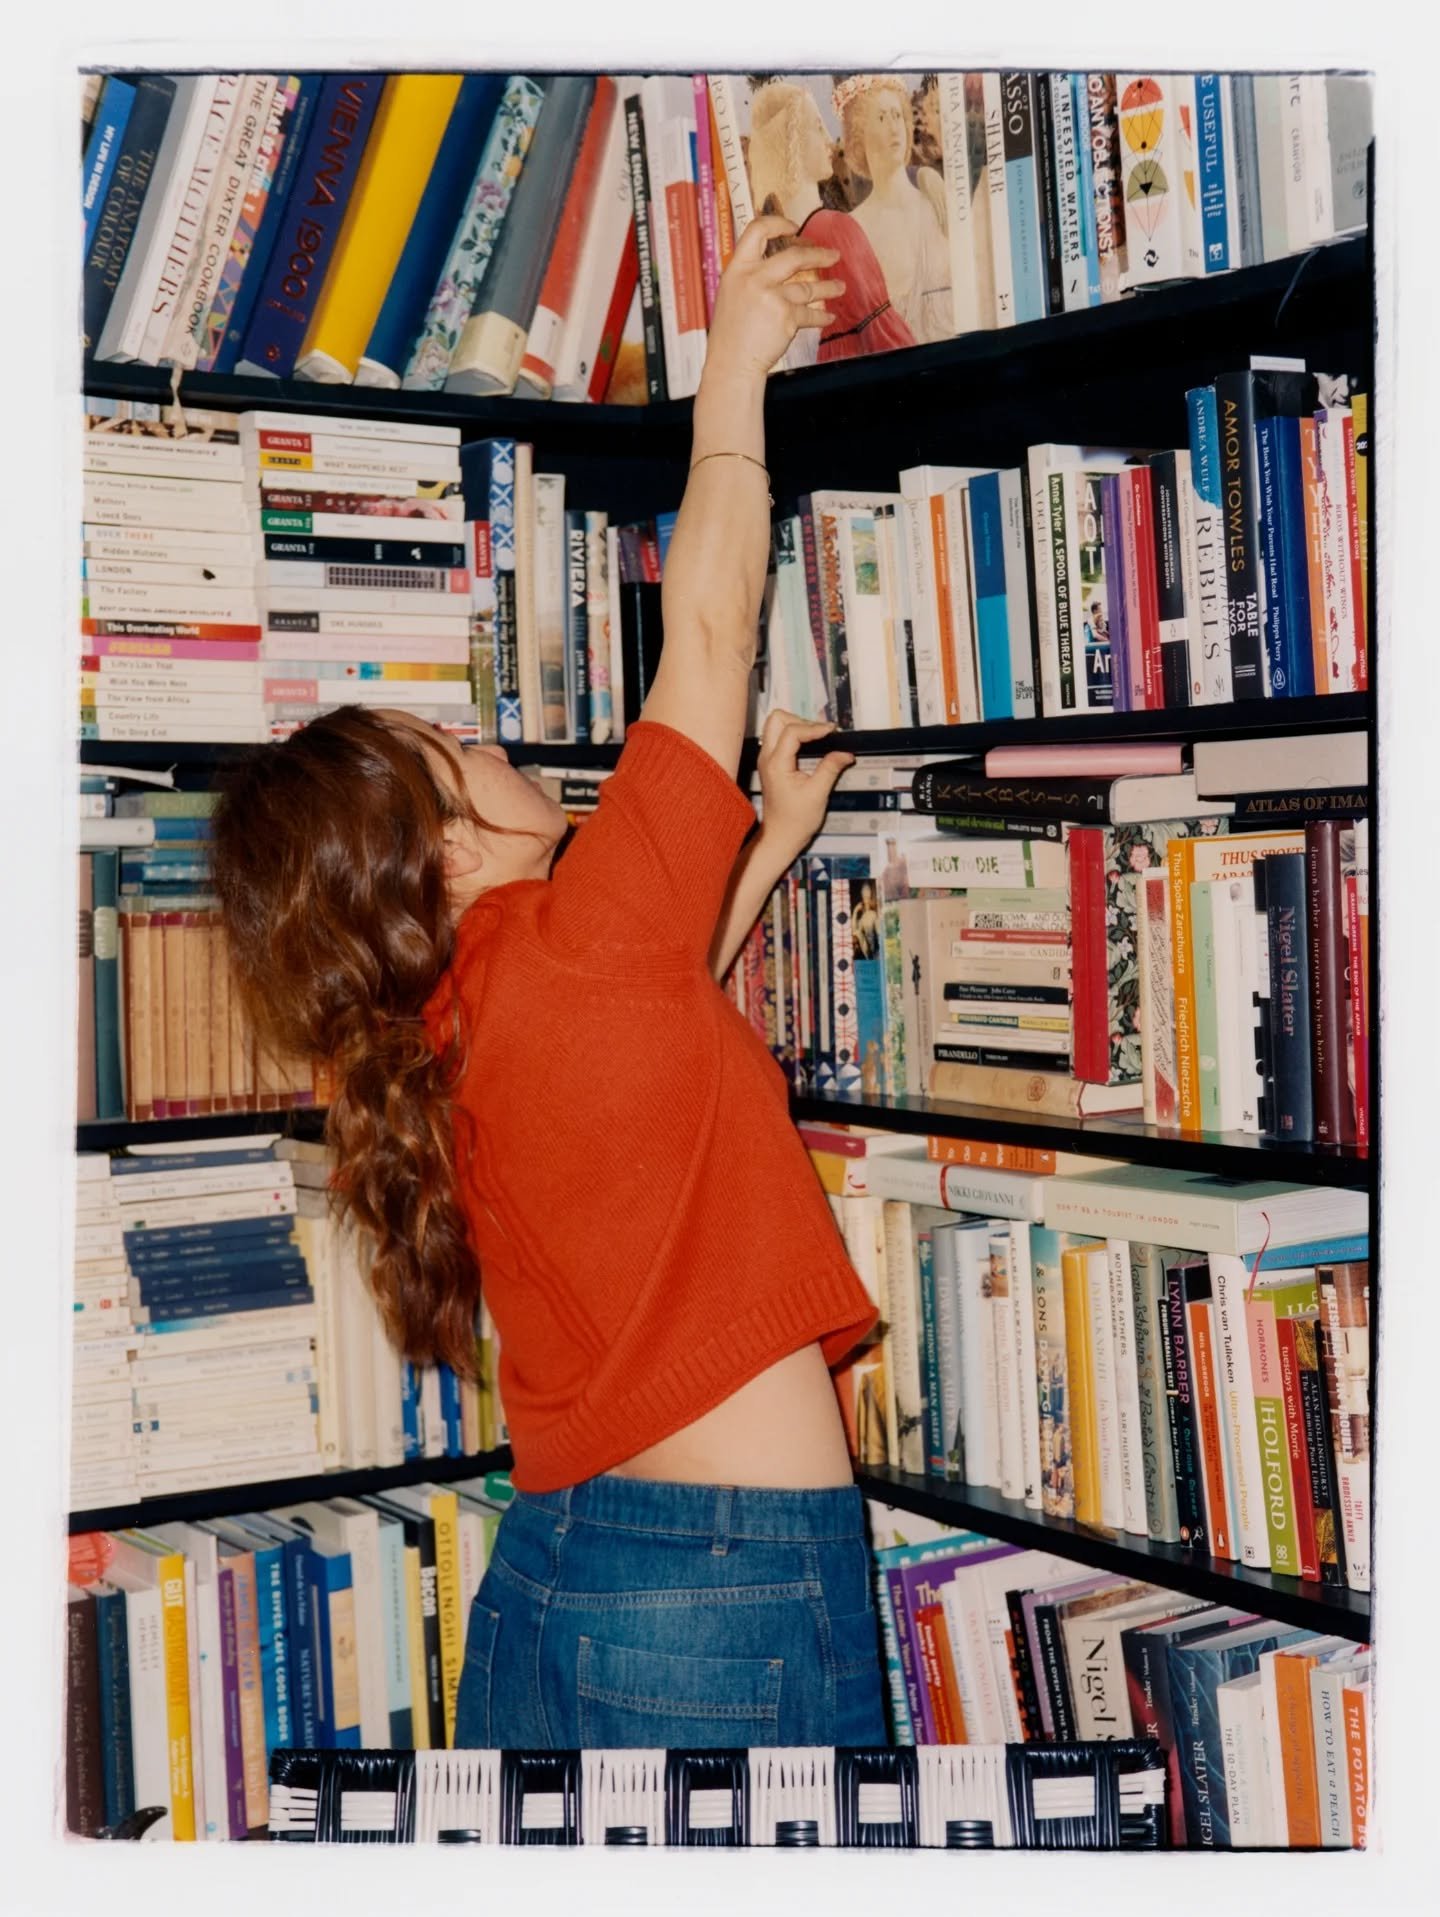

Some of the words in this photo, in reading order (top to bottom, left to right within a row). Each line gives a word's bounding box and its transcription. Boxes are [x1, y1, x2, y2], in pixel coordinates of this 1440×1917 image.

[247, 79, 268, 111] THE
[1053, 86, 1063, 140] COLLECTION
[627, 111, 641, 146] NEW
[1090, 95, 1105, 134] ANY
[1202, 93, 1218, 173] USEFUL
[234, 114, 258, 170] GREAT
[307, 80, 368, 208] VIENNA
[985, 110, 1005, 195] SHAKER
[1061, 95, 1074, 181] INFESTED
[1291, 127, 1301, 182] CRANFORD
[115, 154, 135, 184] OF
[136, 150, 155, 187] THE
[630, 152, 648, 215] ENGLISH
[951, 120, 969, 222] ANGELICO
[214, 175, 241, 238] DIXTER
[1092, 135, 1114, 260] OBJECTIONS?
[90, 184, 123, 269] COLOUR
[103, 190, 142, 290] ANATOMY
[1067, 194, 1080, 262] WATERS
[280, 216, 323, 300] 1900
[636, 216, 652, 309] INTERIORS
[184, 243, 222, 337] COOKBOOK
[267, 436, 303, 447] GRANTA
[1195, 397, 1207, 450] ANDREA
[1224, 399, 1240, 471] AMOR
[1261, 428, 1269, 445] The
[1200, 453, 1210, 494] WULF
[1262, 446, 1270, 465] Book
[267, 495, 303, 504] GRANTA
[1051, 476, 1062, 505] Anne
[1265, 483, 1273, 503] Wish
[267, 517, 303, 528] GRANTA
[1054, 507, 1063, 534] Tyler
[1227, 479, 1245, 573] TOWLES
[1267, 523, 1276, 554] Parents
[270, 543, 306, 553] GRANTA
[803, 513, 817, 584] CHINESE
[1053, 538, 1061, 546] A
[95, 565, 132, 574] LONDON
[570, 529, 585, 608] RIVIERA
[1055, 548, 1066, 580] SPOOL
[1269, 556, 1277, 573] Had
[1057, 584, 1067, 599] OF
[1197, 515, 1221, 661] REBELS
[1271, 574, 1279, 598] Read
[107, 623, 124, 633] This
[126, 624, 175, 636] Overheating
[176, 625, 200, 635] World
[1058, 602, 1069, 632] BLUE
[1228, 599, 1237, 636] TWO
[1236, 601, 1247, 635] FOR
[1246, 592, 1259, 638] TABLE
[1273, 606, 1281, 640] Philippa
[1060, 633, 1071, 675] THREAD
[108, 712, 141, 721] Country
[937, 784, 1080, 807] KATABASIS
[1246, 798, 1299, 813] ATLAS
[1303, 797, 1327, 811] OF
[932, 857, 960, 874] NOT
[975, 856, 999, 874] DIE
[1174, 852, 1182, 874] Thus
[1220, 852, 1258, 866] THUS
[1174, 876, 1182, 906] Spoke
[1312, 889, 1320, 930] barber
[1175, 906, 1185, 974] Zarathustra
[1279, 907, 1297, 967] Nigel
[1313, 937, 1321, 995] interviews
[1179, 997, 1188, 1051] Friedrich
[1281, 975, 1297, 1037] Slater
[938, 1049, 977, 1060] PIRANDELLO
[1316, 1038, 1324, 1075] barber
[1181, 1055, 1191, 1117] Nietzsche
[949, 1184, 973, 1202] NIKKI
[971, 1187, 1015, 1208] GIOVANNI
[1102, 1208, 1133, 1221] TOURIST
[1148, 1214, 1179, 1226] LONDON
[1114, 1252, 1122, 1305] MOTHERS,
[1217, 1275, 1228, 1308] Chris
[1037, 1286, 1048, 1332] SONS
[1160, 1304, 1169, 1336] PENGUIN
[1168, 1281, 1185, 1329] LYNN
[1221, 1310, 1229, 1331] van
[1117, 1310, 1126, 1359] FATHERS,
[1256, 1318, 1270, 1384] HORMONES
[1039, 1338, 1051, 1399] DAVID
[1163, 1337, 1172, 1371] PARALLEL
[1173, 1334, 1190, 1404] BARBER
[1223, 1334, 1235, 1384] Tulleken
[1281, 1345, 1294, 1392] tuesdays
[926, 1322, 935, 1364] THINGS
[931, 1409, 940, 1448] ASLEEP
[1166, 1371, 1174, 1388] TEXT
[1287, 1394, 1296, 1419] with
[1184, 1428, 1193, 1473] Curious
[1229, 1390, 1245, 1488] Ultra-Processed
[1290, 1421, 1300, 1460] Morrie
[1304, 1394, 1317, 1467] Swimming-Pool
[1311, 1469, 1320, 1505] Library
[1314, 1415, 1329, 1497] HOLLINGHURST
[1122, 1437, 1131, 1492] HUSTVEDT
[1260, 1401, 1287, 1531] HOLFORD
[1239, 1490, 1250, 1531] People
[1354, 1500, 1363, 1521] TAFFY
[165, 1578, 184, 1608] GUT
[270, 1562, 281, 1587] THE
[420, 1566, 436, 1617] Bacon
[438, 1521, 456, 1648] OTTOLENGHI
[272, 1590, 282, 1629] RIVER
[890, 1584, 901, 1606] The
[895, 1609, 906, 1639] Later
[1043, 1618, 1052, 1646] FROM
[274, 1631, 284, 1664] CAFE
[901, 1642, 912, 1676] Years
[1047, 1647, 1055, 1665] THE
[276, 1666, 286, 1702] COOK
[299, 1648, 313, 1709] NATURE'S
[1051, 1666, 1060, 1692] OVEN
[1081, 1636, 1117, 1724] Nigel
[908, 1682, 918, 1713] Peter
[1321, 1690, 1331, 1723] HOW
[278, 1705, 288, 1742] BOOK
[1058, 1708, 1066, 1727] THE
[1349, 1706, 1361, 1740] THE
[1225, 1727, 1233, 1748] THE
[1324, 1728, 1333, 1746] TO
[1194, 1741, 1210, 1804] SLATER
[1227, 1752, 1236, 1792] 10-DAY
[1326, 1751, 1335, 1776] EAT
[1353, 1746, 1368, 1818] POTATO
[1231, 1796, 1241, 1824] PLAN
[1329, 1792, 1340, 1837] PEACH
